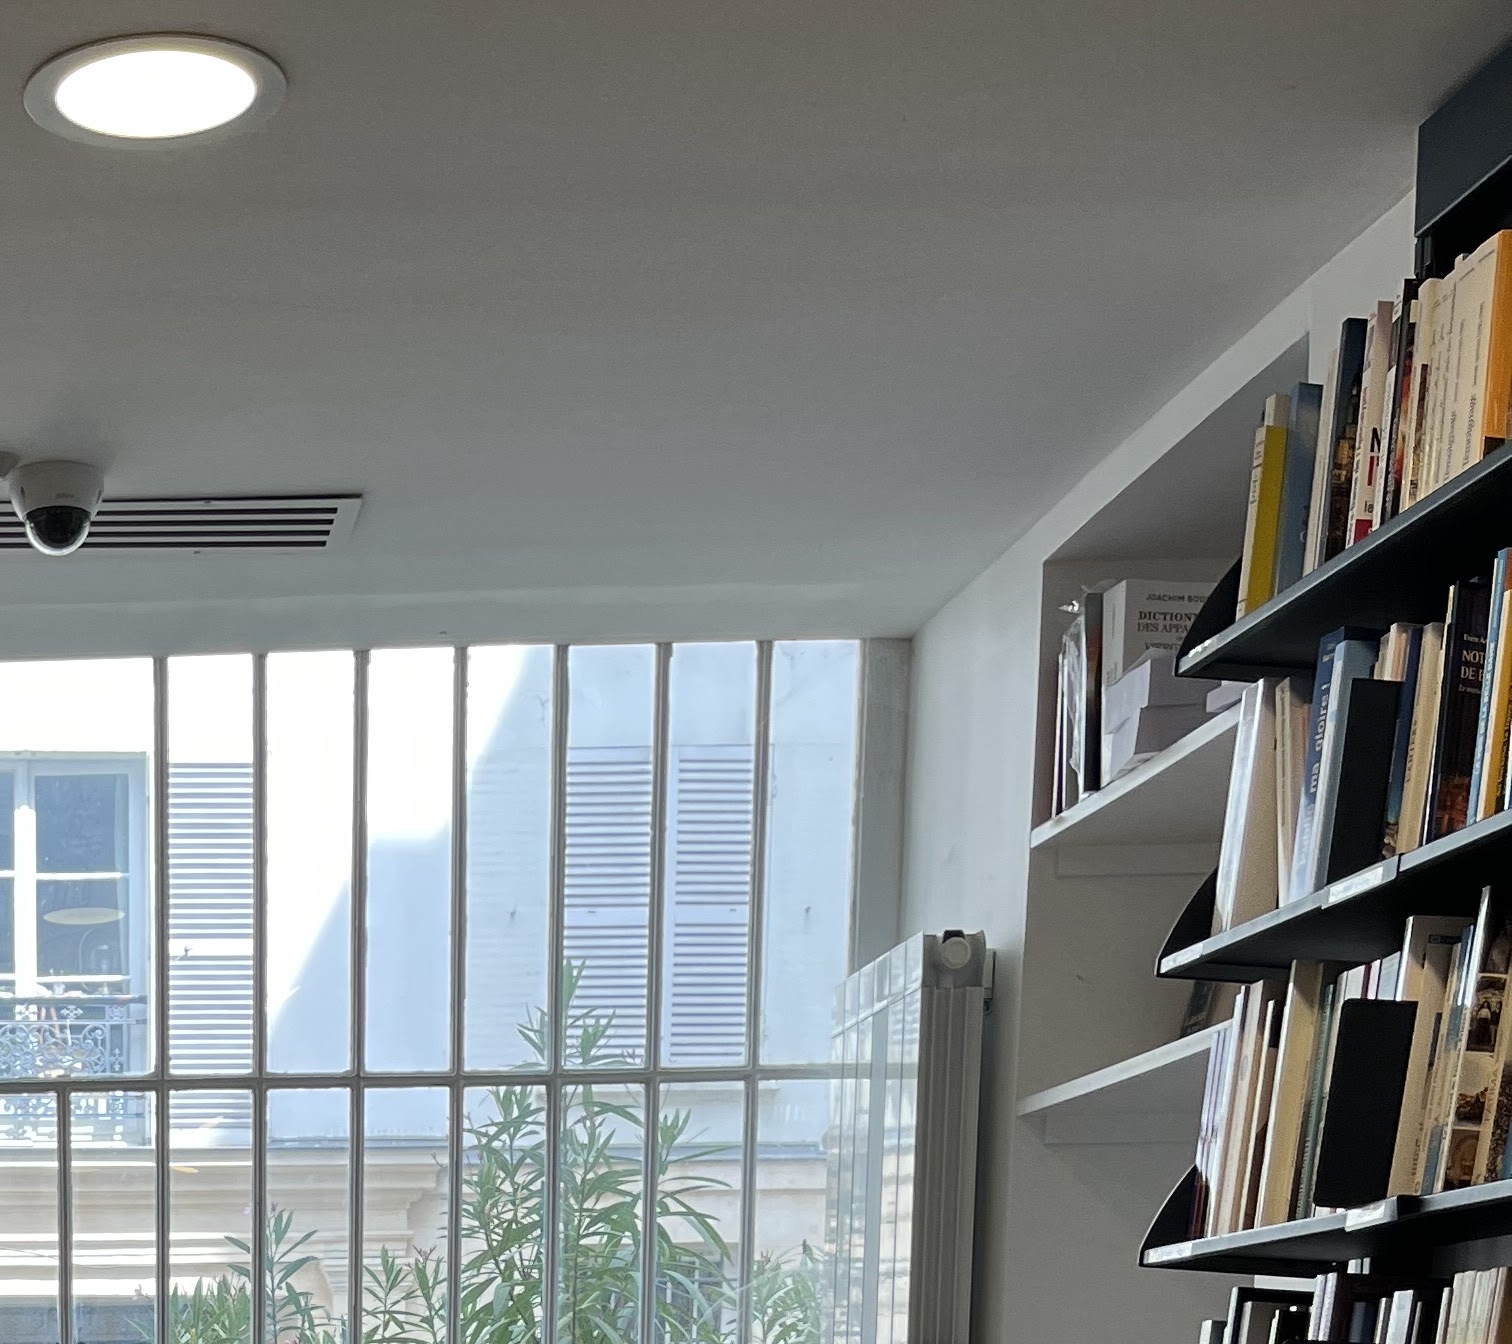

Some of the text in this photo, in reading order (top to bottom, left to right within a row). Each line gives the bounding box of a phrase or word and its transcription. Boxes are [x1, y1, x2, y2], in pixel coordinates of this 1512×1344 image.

[1137, 622, 1158, 633] DES
[1315, 697, 1329, 752] gloire
[1310, 764, 1321, 793] ma
